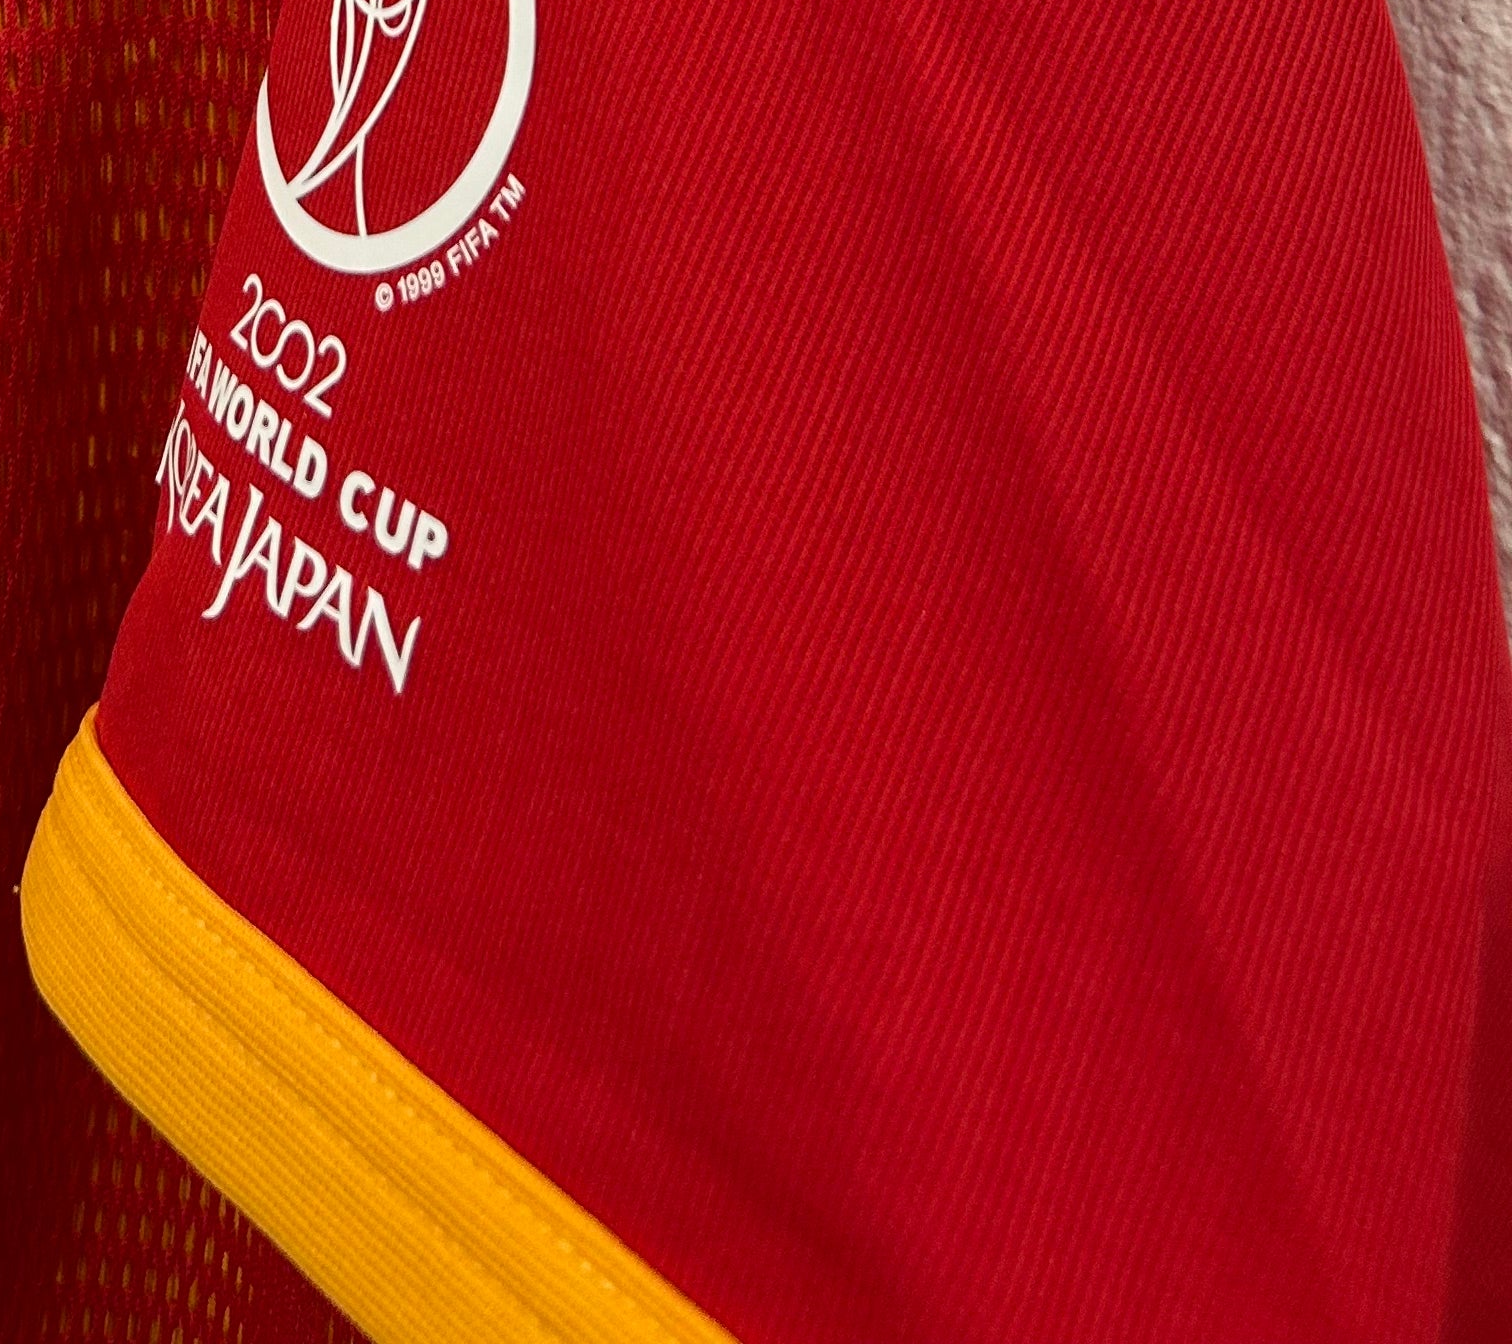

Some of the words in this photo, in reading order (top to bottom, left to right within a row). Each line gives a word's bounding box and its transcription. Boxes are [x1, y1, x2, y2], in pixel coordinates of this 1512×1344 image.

[397, 259, 445, 304] 1999
[446, 218, 500, 277] FIFA
[489, 172, 527, 222] TM
[230, 273, 347, 419] 2002
[186, 325, 213, 400] IFA
[208, 357, 328, 500] WORLD
[339, 470, 448, 572] CUP
[201, 483, 422, 696] JAPAN
